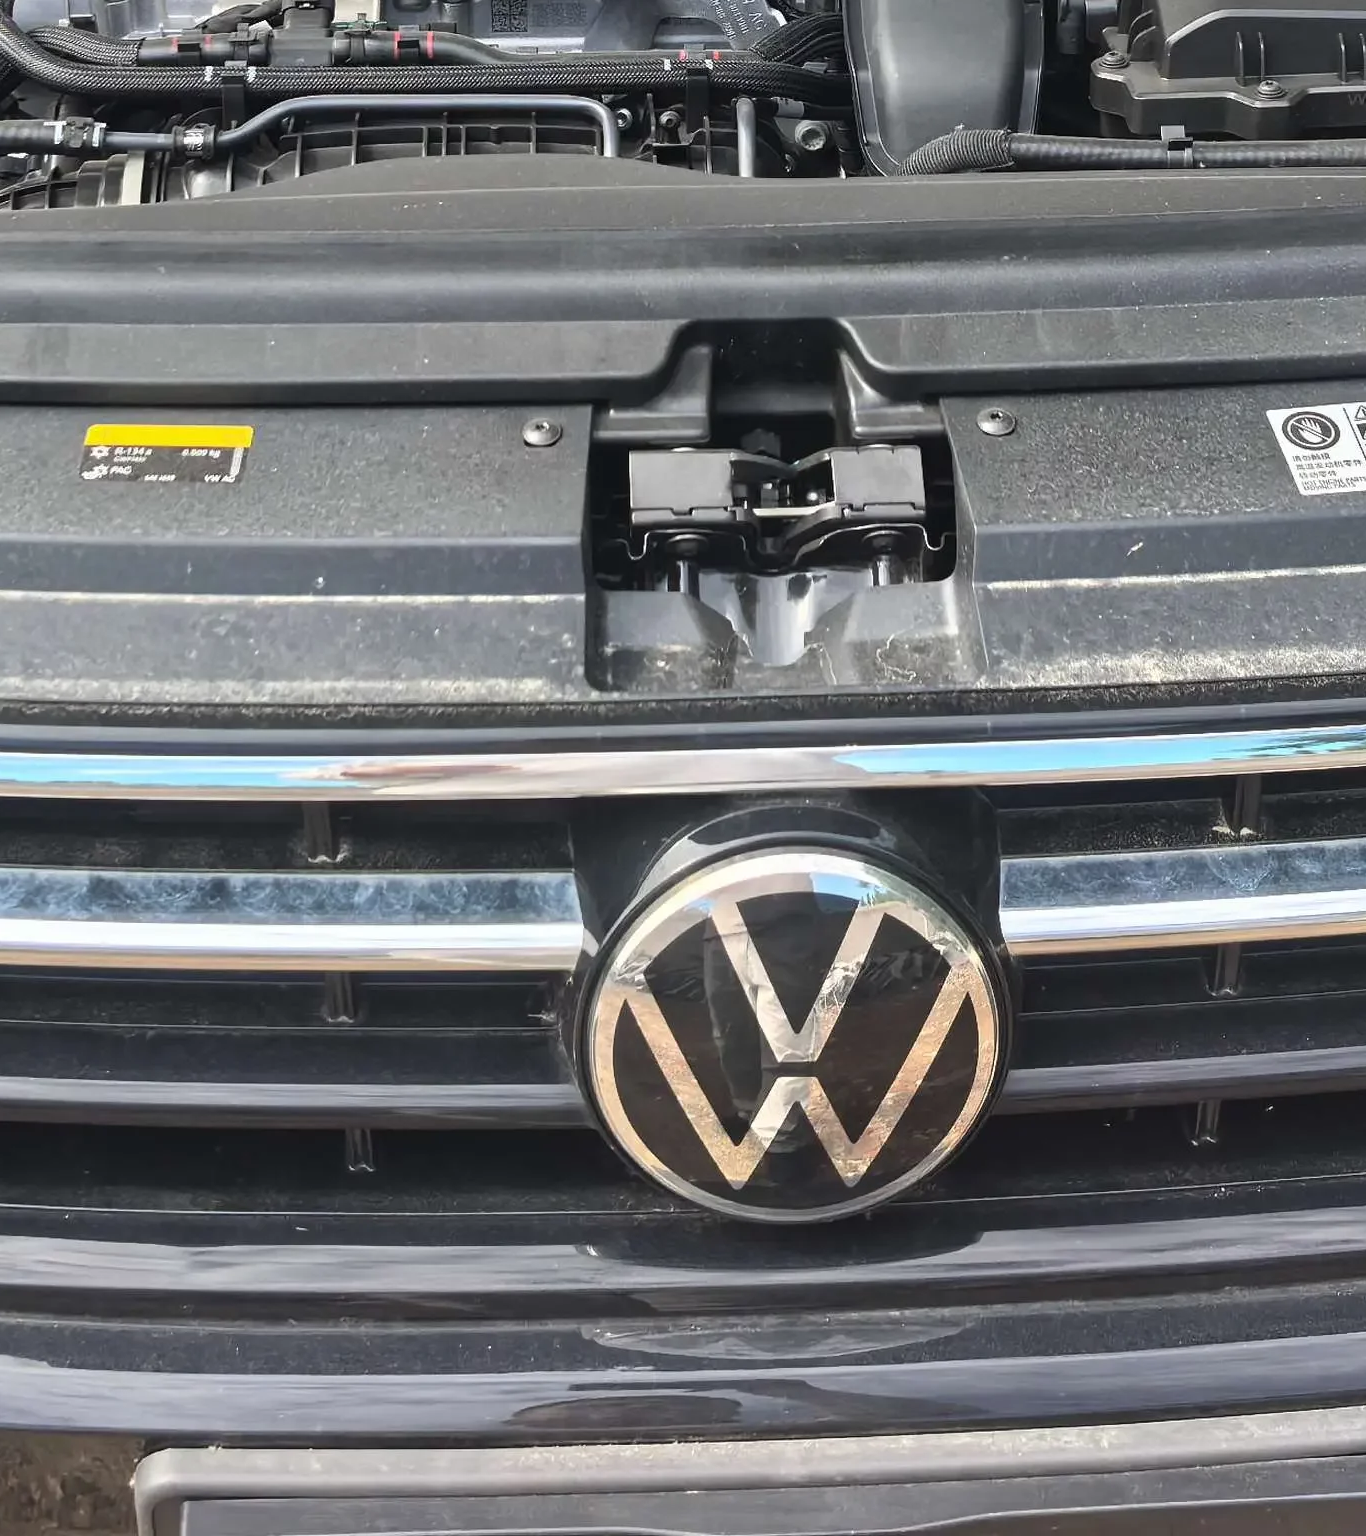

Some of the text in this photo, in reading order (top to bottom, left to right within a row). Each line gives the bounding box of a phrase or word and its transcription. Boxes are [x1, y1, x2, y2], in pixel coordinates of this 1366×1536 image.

[204, 474, 221, 483] VW
[221, 474, 236, 483] AG
[607, 876, 983, 1204] VW
